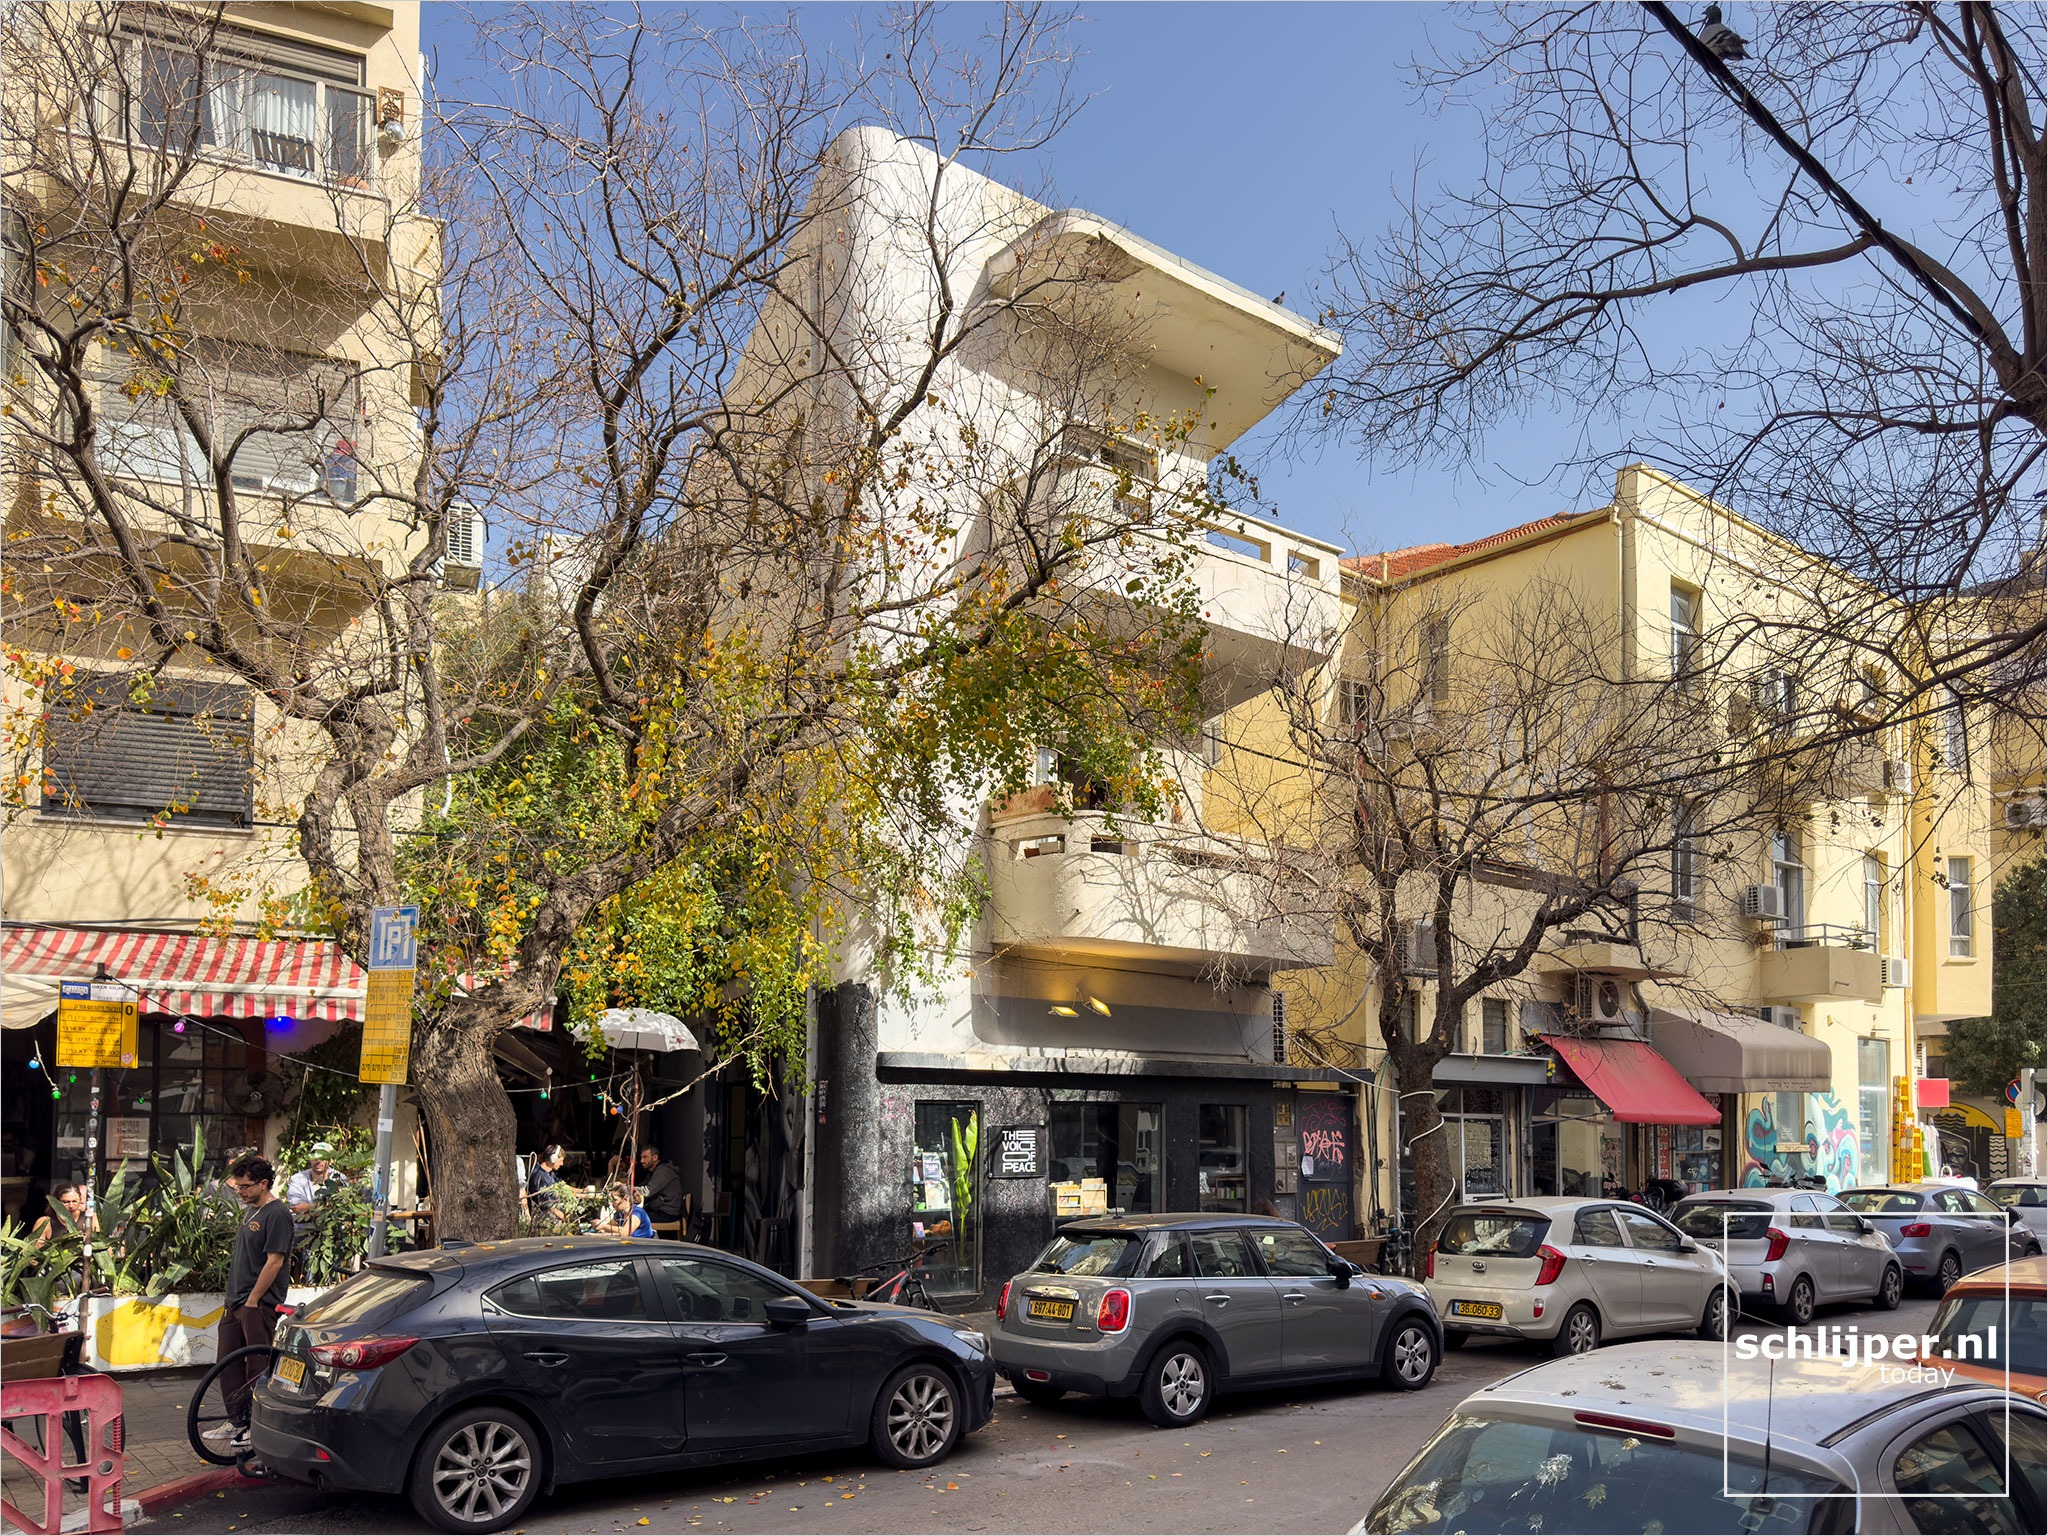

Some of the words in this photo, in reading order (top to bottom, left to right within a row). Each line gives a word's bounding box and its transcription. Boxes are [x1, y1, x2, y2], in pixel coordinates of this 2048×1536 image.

[125, 1004, 133, 1016] 0
[1002, 1130, 1036, 1141] THE
[1002, 1140, 1036, 1151] VOICE
[1002, 1151, 1036, 1162] OF
[1002, 1162, 1037, 1173] PEACE
